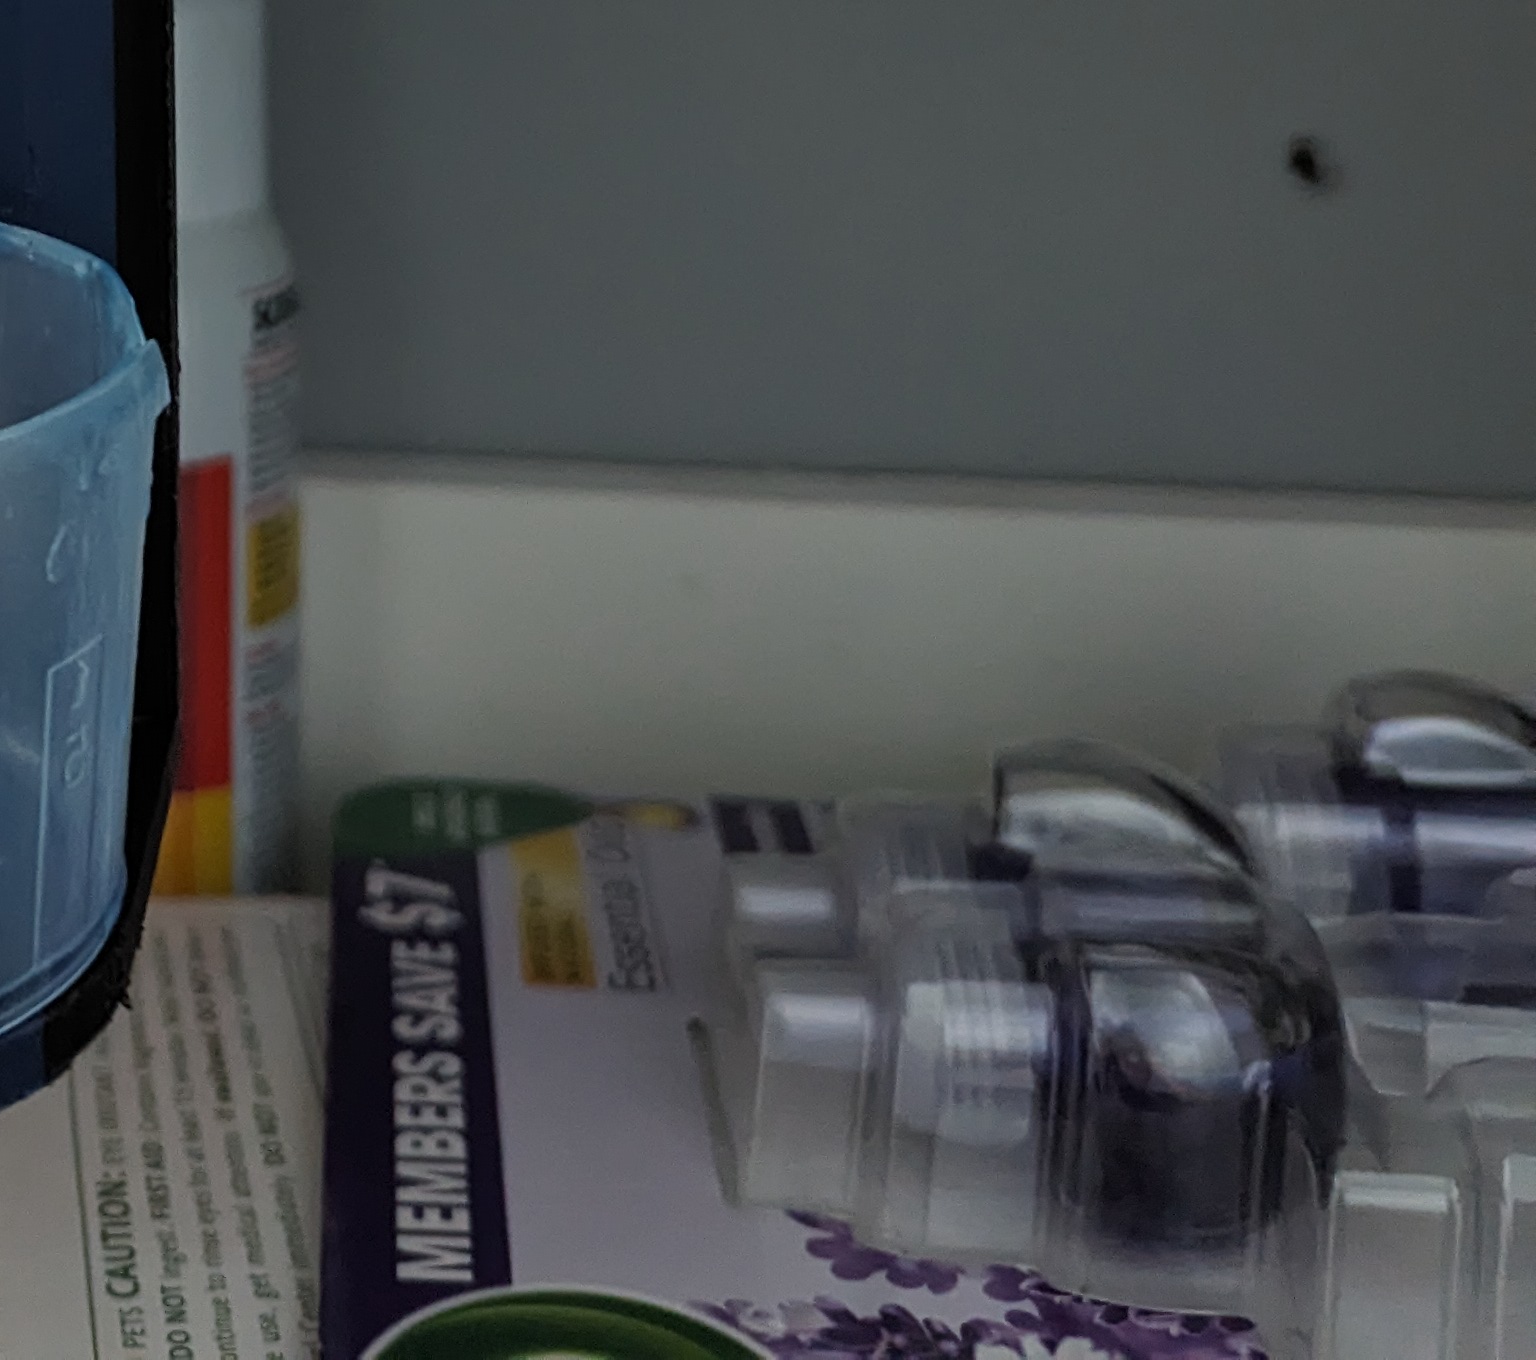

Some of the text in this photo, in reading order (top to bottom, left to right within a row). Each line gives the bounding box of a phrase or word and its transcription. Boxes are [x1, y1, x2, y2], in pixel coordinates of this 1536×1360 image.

[390, 938, 464, 1046] SAVE
[391, 1050, 474, 1283] MEMBERS
[97, 1171, 139, 1299] CAUTION:
[119, 1307, 145, 1349] PETS
[161, 1284, 186, 1323] NOT
